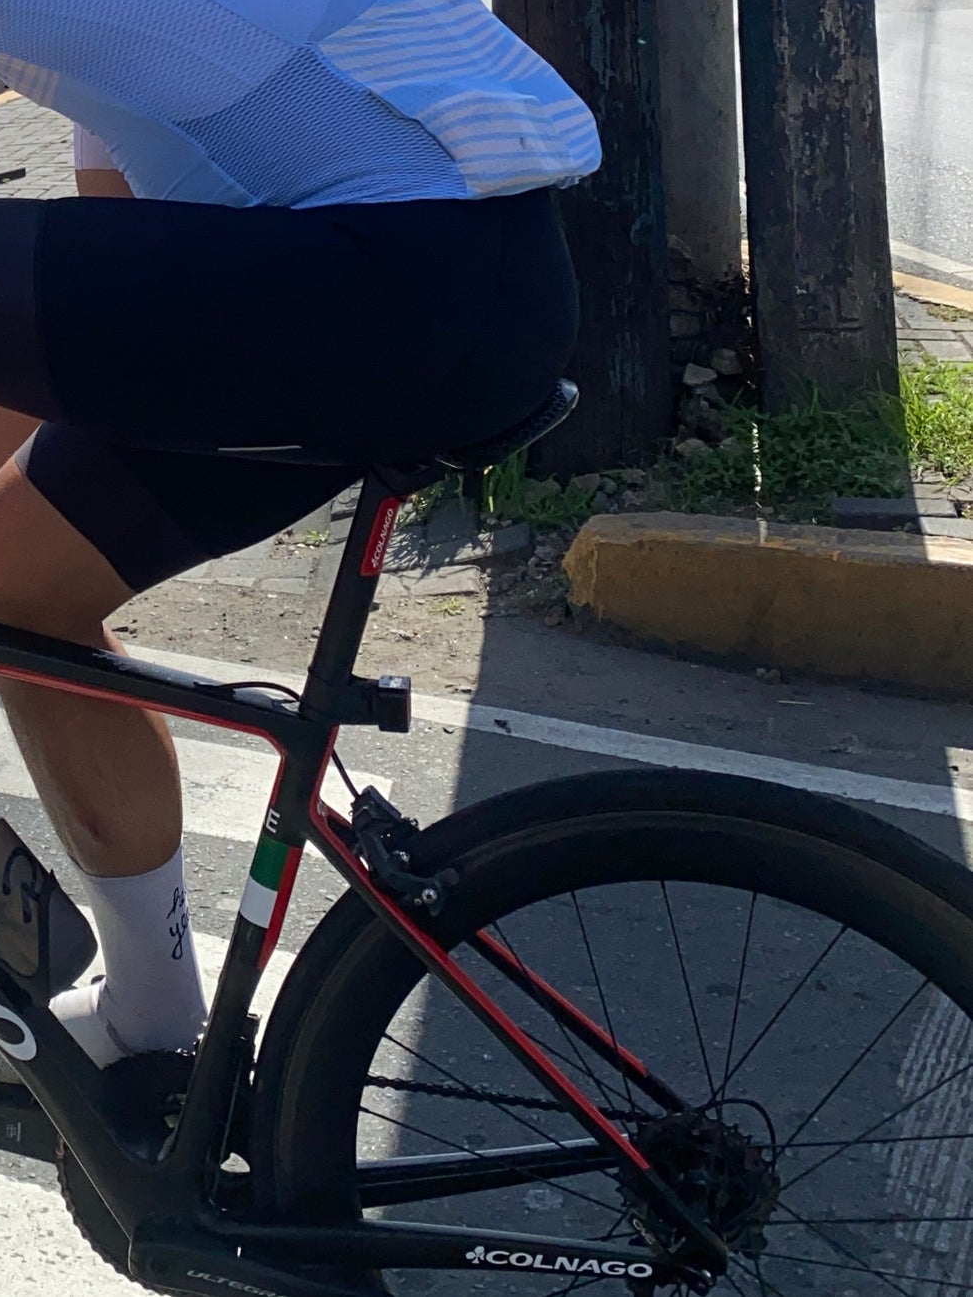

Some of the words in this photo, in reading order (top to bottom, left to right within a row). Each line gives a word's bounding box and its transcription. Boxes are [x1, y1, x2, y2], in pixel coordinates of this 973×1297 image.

[373, 508, 394, 561] COLNAGO
[485, 1250, 653, 1278] COLNAGO
[186, 1269, 288, 1297] ULTEGR
